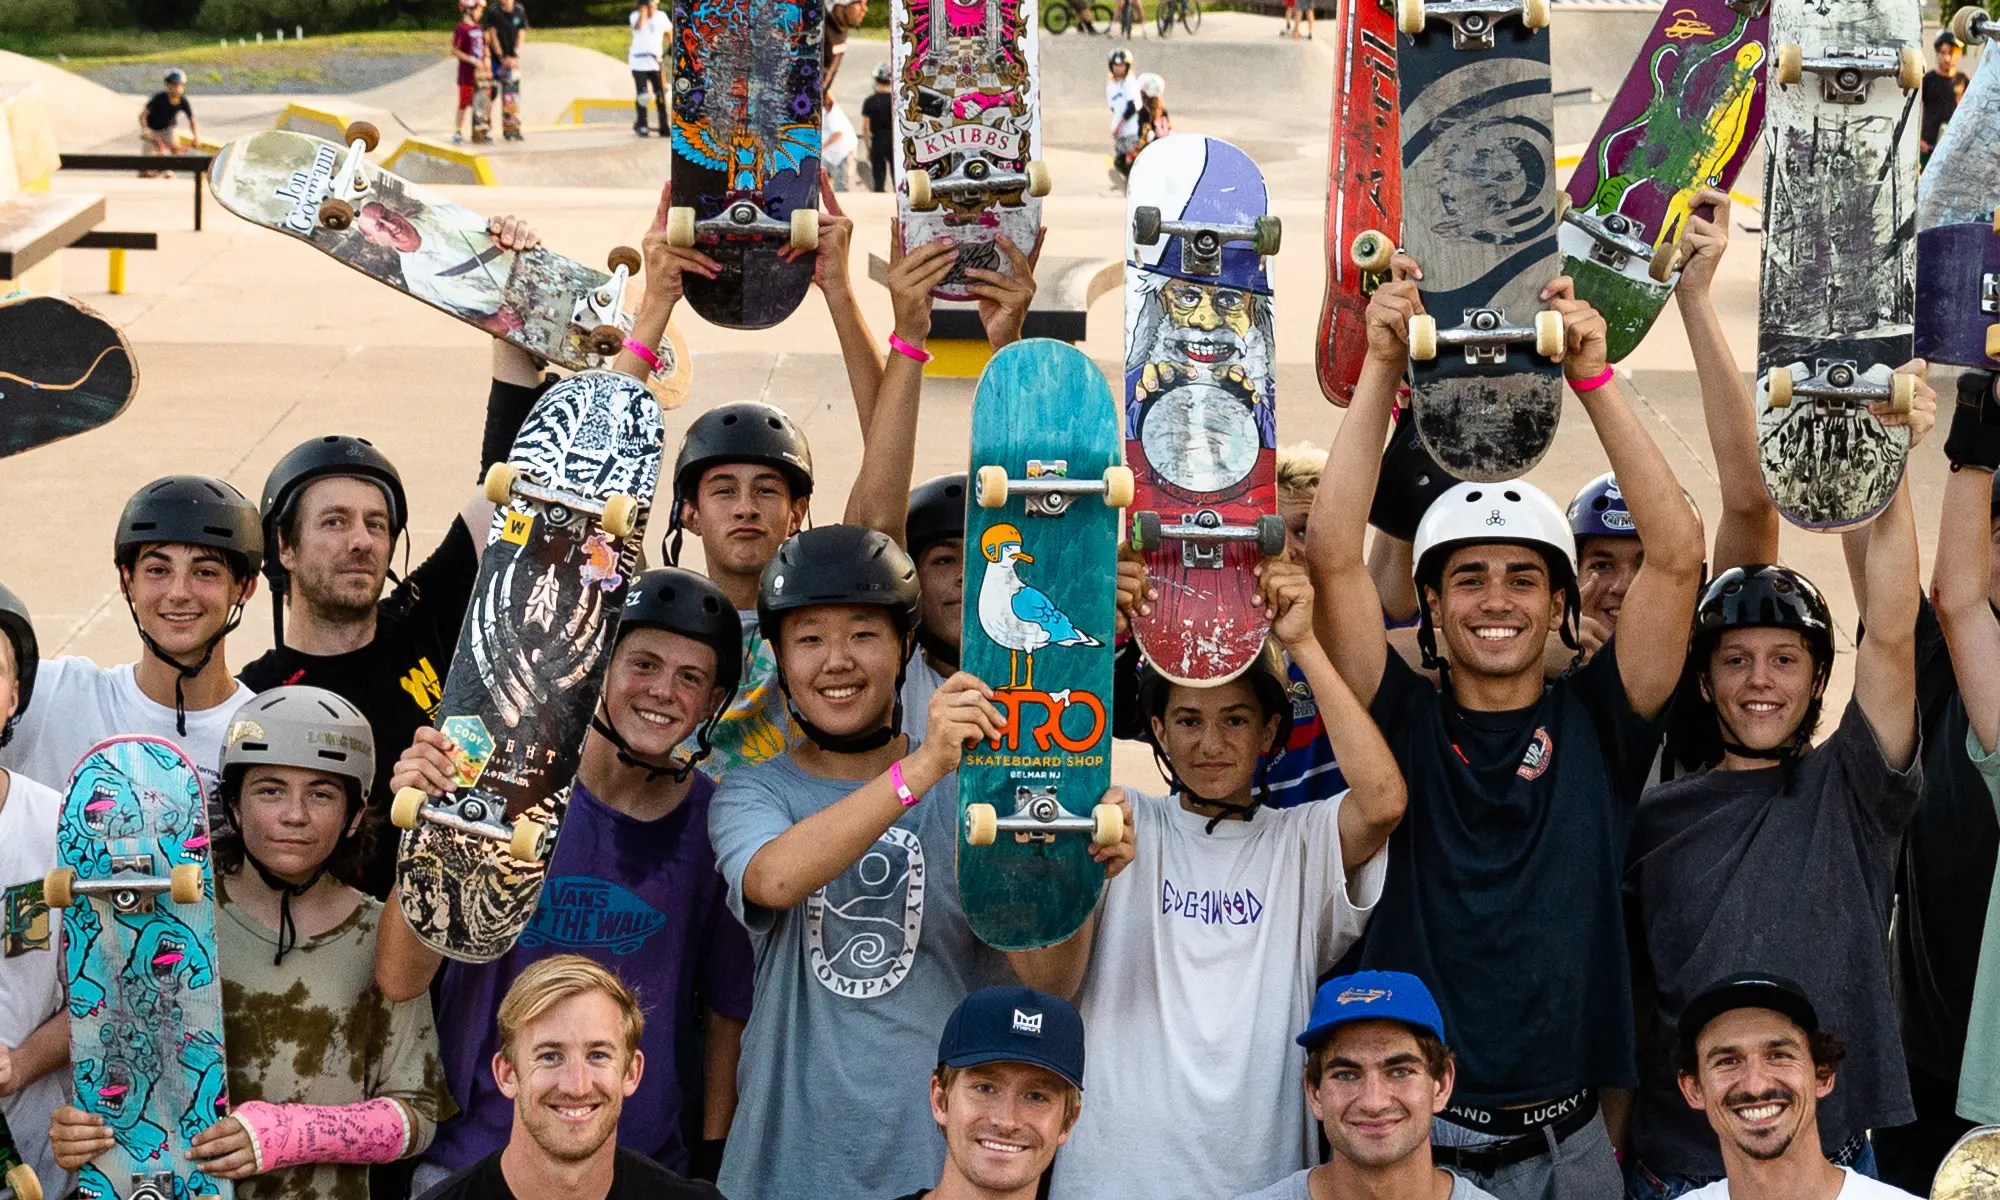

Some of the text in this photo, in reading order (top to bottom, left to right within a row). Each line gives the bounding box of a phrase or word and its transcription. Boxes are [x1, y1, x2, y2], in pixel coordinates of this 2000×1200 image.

[924, 128, 1010, 154] KNIBBS
[276, 172, 308, 205] Jon
[510, 519, 526, 535] W
[455, 724, 485, 745] CODY
[966, 755, 1104, 767] SKATEBOARD SHOP
[1010, 771, 1061, 779] BELMAR NJ
[884, 828, 924, 917] SUPPLY
[550, 881, 610, 909] VANS
[1162, 878, 1263, 925] EDGEWOOD
[551, 906, 595, 940] THE
[810, 943, 914, 996] COMPANY
[1445, 1094, 1579, 1126] AND LUCKY
